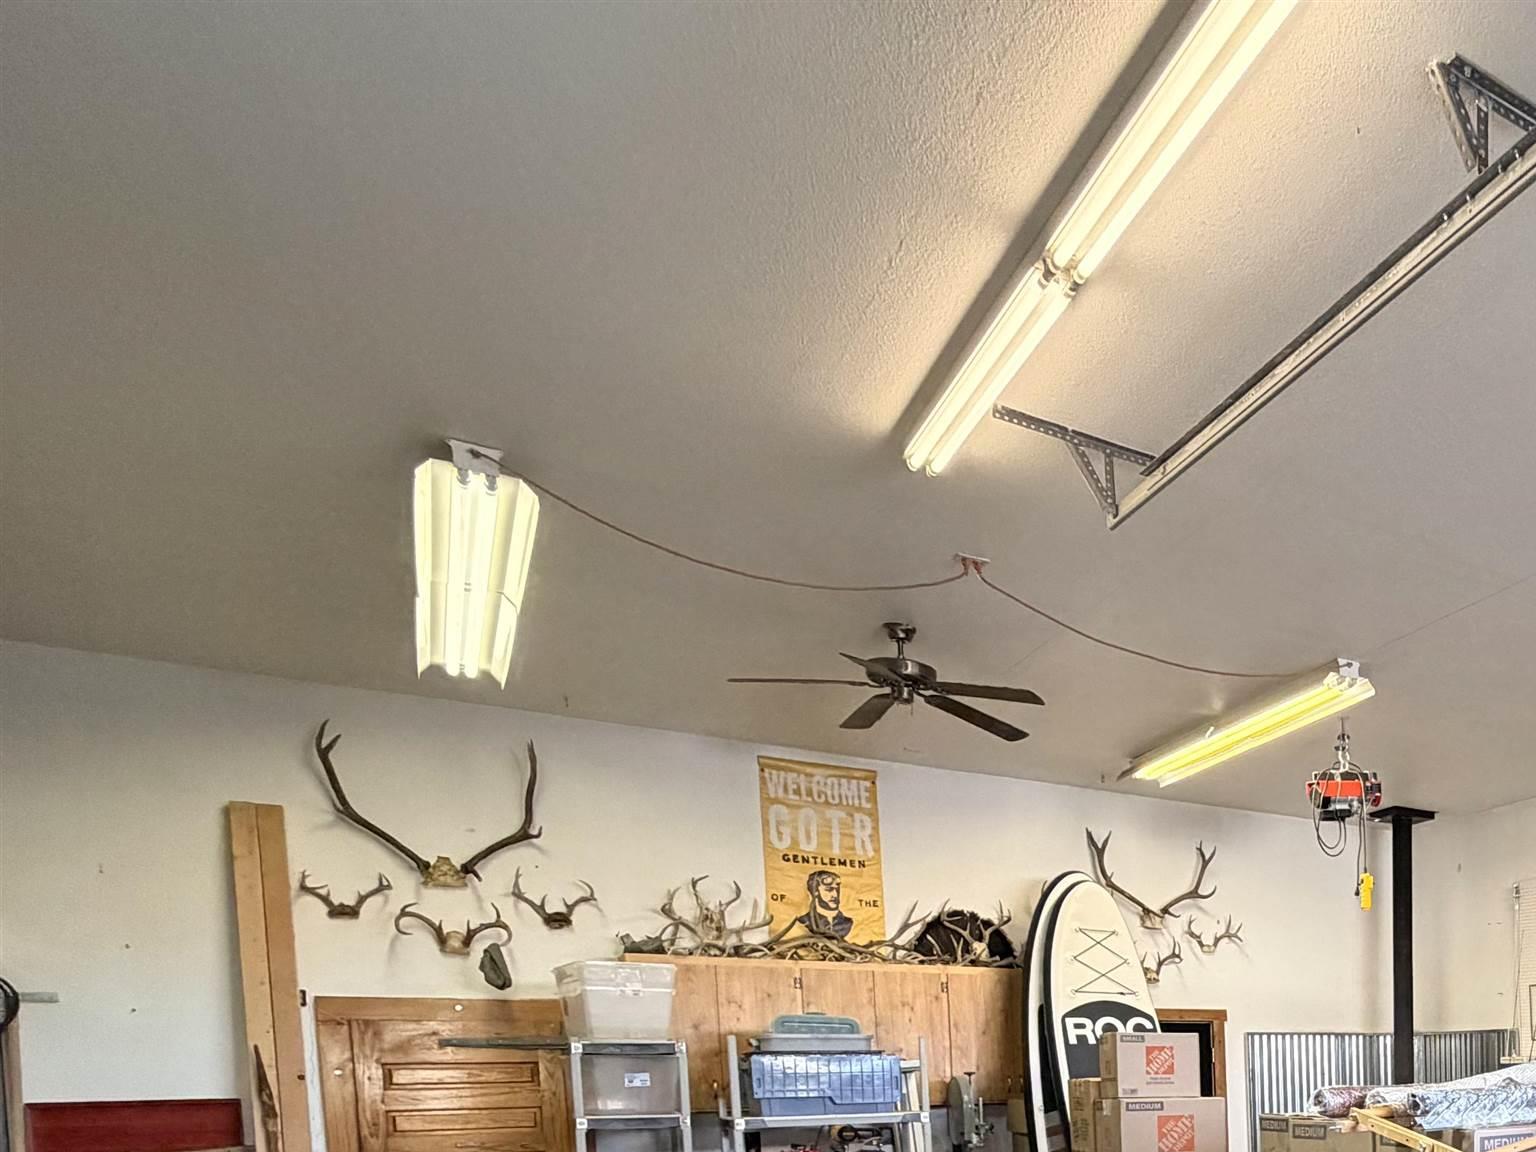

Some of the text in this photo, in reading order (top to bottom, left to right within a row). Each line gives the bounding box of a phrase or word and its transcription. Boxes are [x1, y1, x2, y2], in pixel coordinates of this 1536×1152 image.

[764, 769, 871, 808] WELCOME
[768, 804, 875, 858] GOTR
[782, 854, 866, 868] GENTLEMEN
[771, 893, 786, 902] OF
[858, 899, 879, 907] THE
[1065, 1016, 1153, 1045] ROC
[1262, 1119, 1288, 1129] MEDIUM
[1294, 1127, 1326, 1138] MEDIUM
